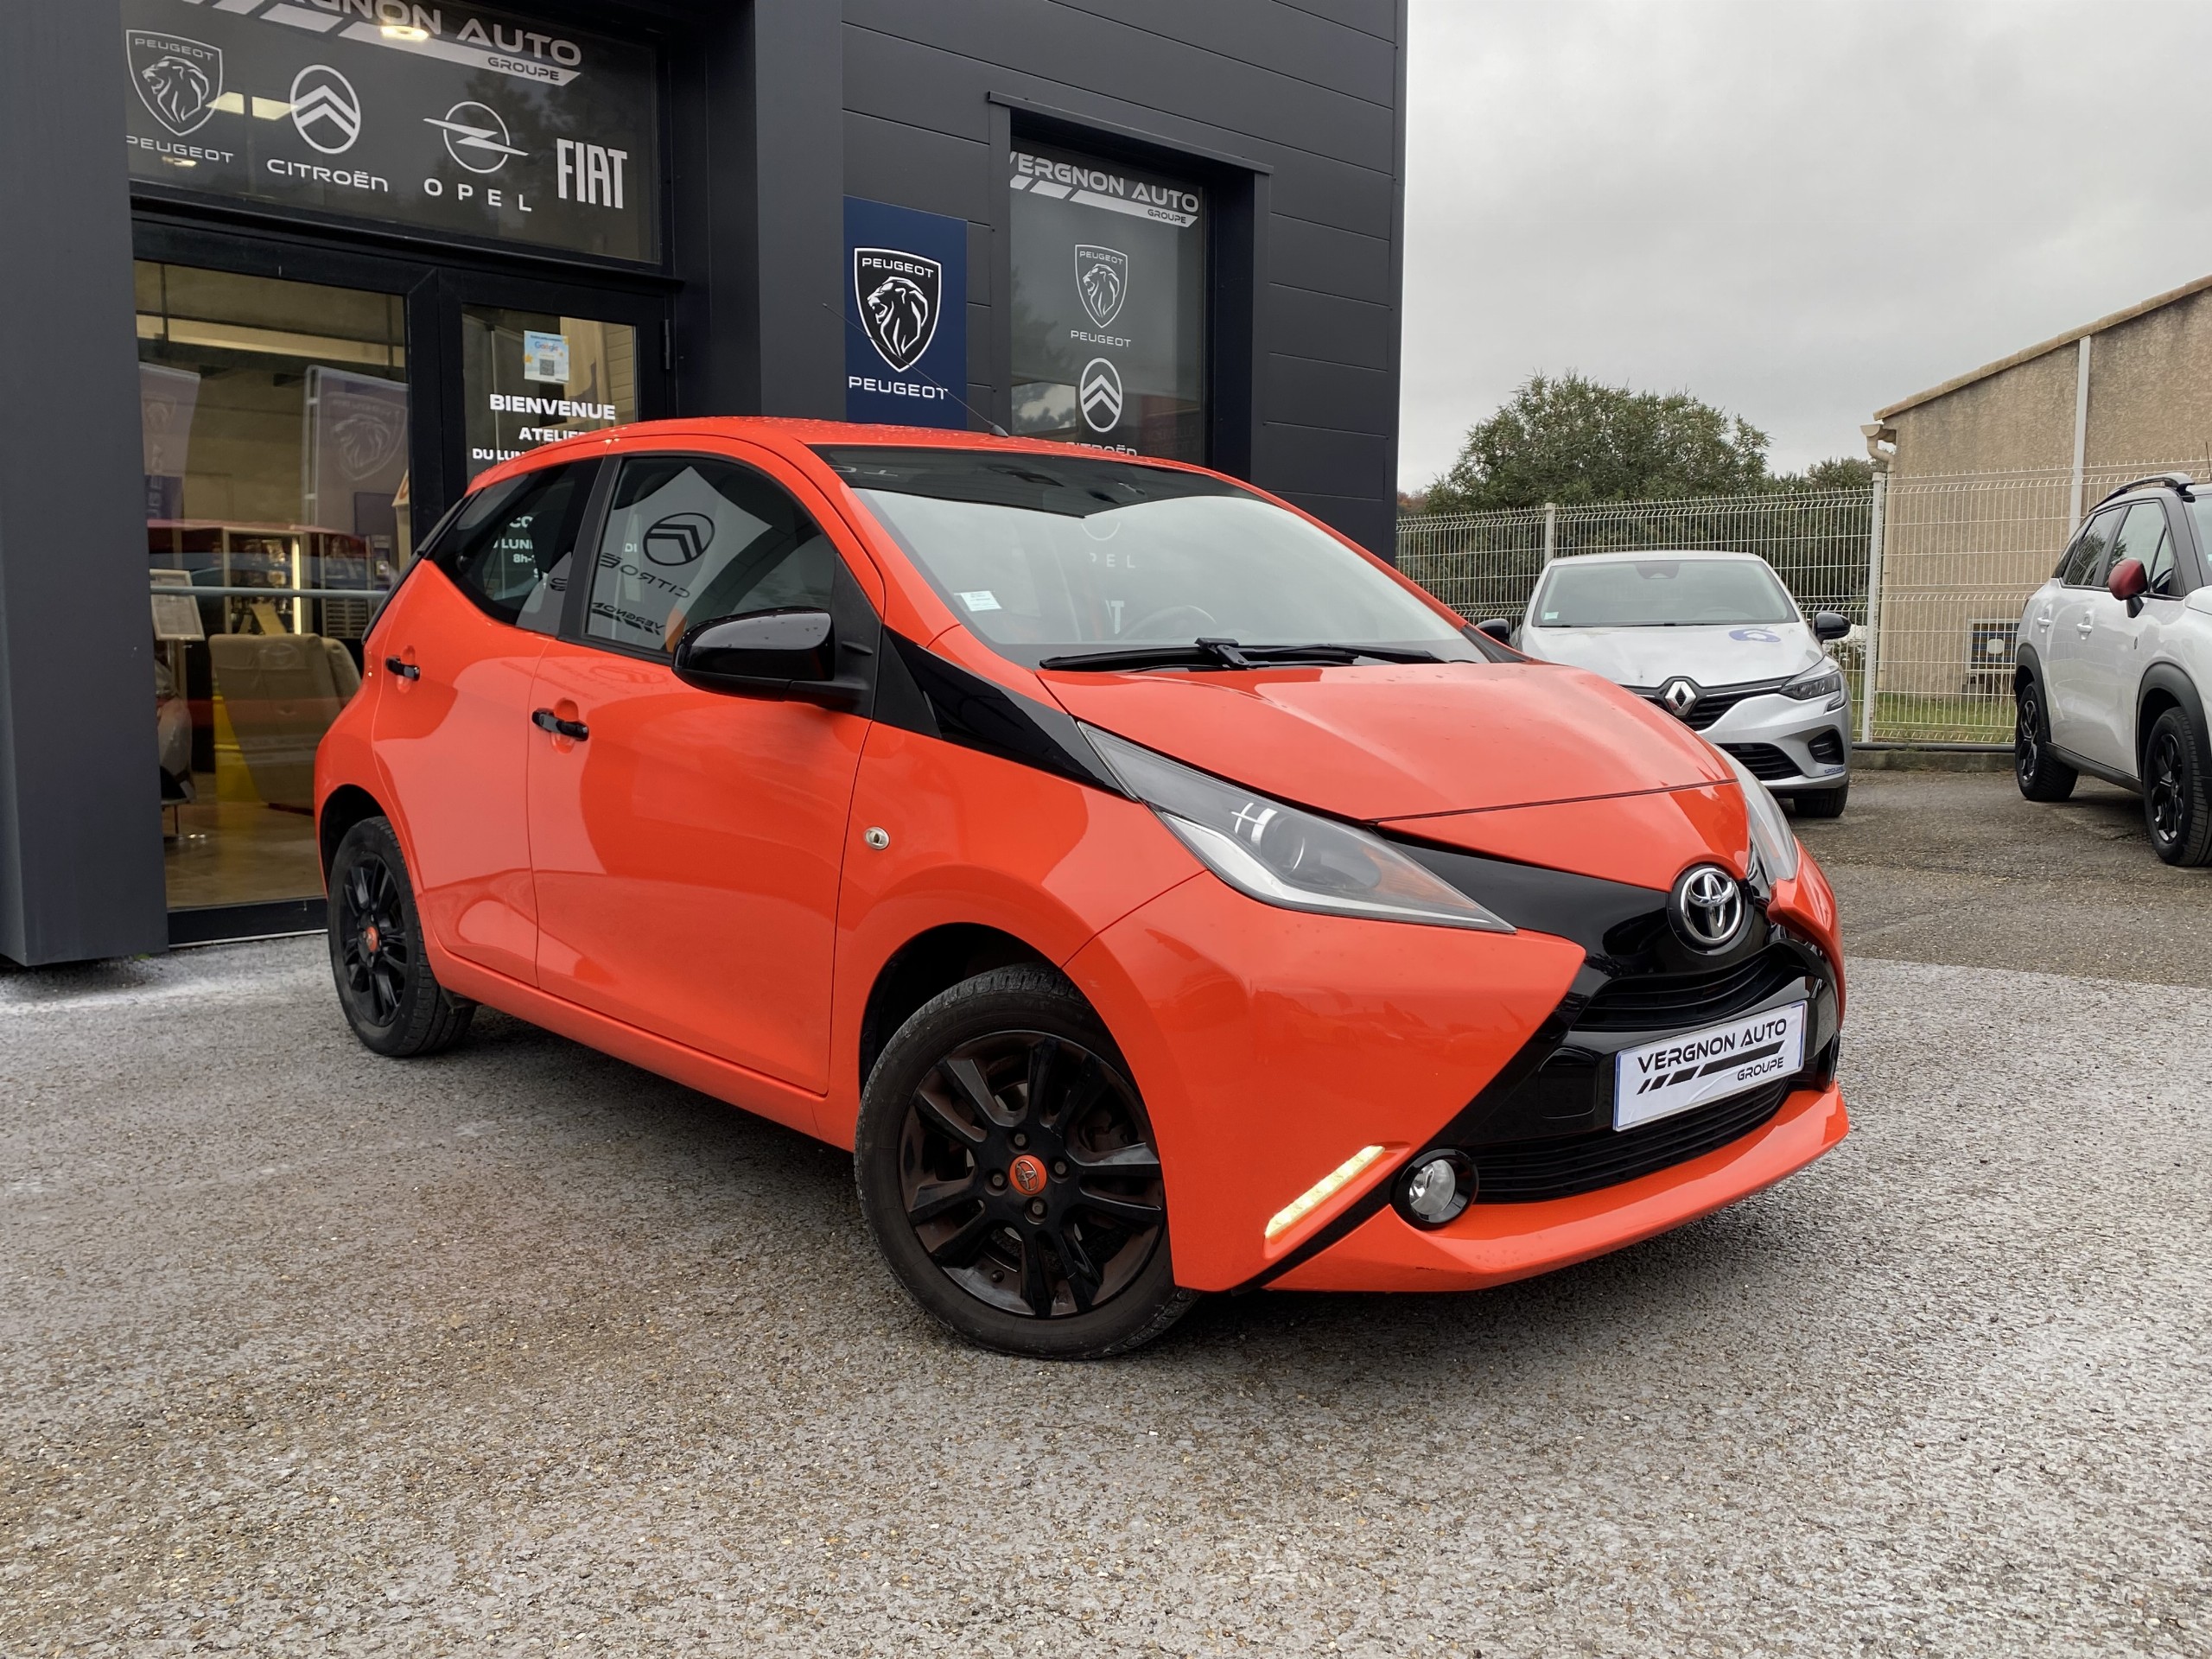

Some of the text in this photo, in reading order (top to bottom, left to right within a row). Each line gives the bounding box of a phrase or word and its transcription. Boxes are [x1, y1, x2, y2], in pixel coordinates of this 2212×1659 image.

[134, 38, 214, 60] PEUGEOT
[456, 18, 582, 67] AUTO
[487, 56, 560, 81] GROUPE
[556, 137, 628, 209] FIAT
[423, 178, 532, 212] OPEL
[1131, 181, 1199, 213] AUTO
[1147, 208, 1186, 224] GROUPE
[861, 257, 934, 278] PEUGEOT
[1079, 251, 1123, 264] PEUGEOT
[1071, 330, 1131, 347] PEUGEOT
[849, 376, 949, 400] PEUGEOT
[489, 393, 616, 420] BIENVENUE
[518, 427, 588, 442] ATELIE
[472, 448, 493, 460] DU
[1637, 1018, 1787, 1074] VERGNON AUTO
[1737, 1056, 1784, 1082] GROUPE
